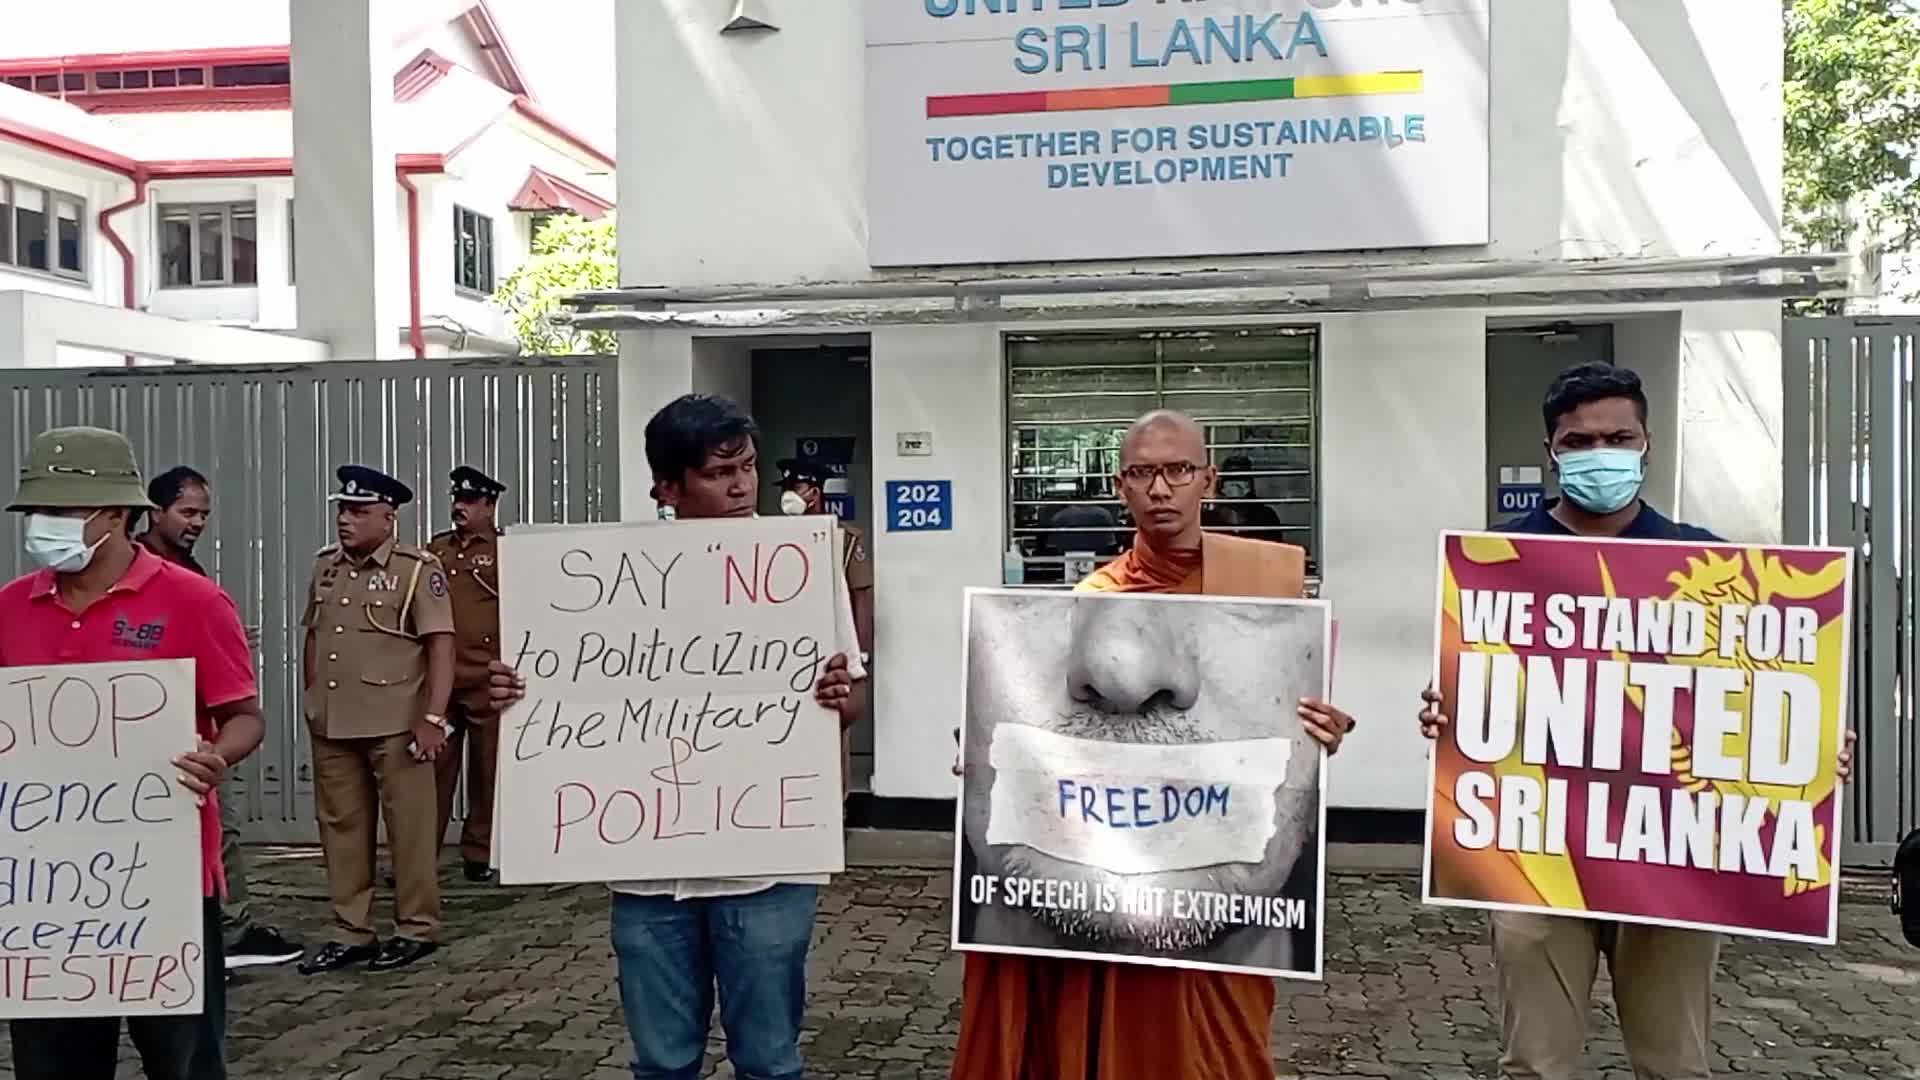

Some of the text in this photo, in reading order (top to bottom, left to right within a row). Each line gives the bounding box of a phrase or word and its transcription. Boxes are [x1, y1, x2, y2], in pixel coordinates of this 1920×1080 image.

[1013, 11, 1328, 75] SRI LANKA
[926, 114, 1426, 162] TOGETHER FOR SUSTAINABLE
[1047, 153, 1293, 189] DEVELOPMENT
[896, 484, 941, 504] 202
[897, 507, 942, 528] 204
[1502, 492, 1541, 509] OUT
[550, 549, 683, 612] SAY
[513, 630, 560, 679] to
[1458, 589, 1819, 664] WE STAND FOR
[514, 691, 802, 761] the Military
[1454, 651, 1822, 787] UNITED
[553, 774, 820, 854] POLICE
[1057, 778, 1231, 828] FREEDOM
[1452, 771, 1818, 882] SRI LANKA
[970, 874, 1306, 930] OF SPEECH IS NOT EXTREMISM
